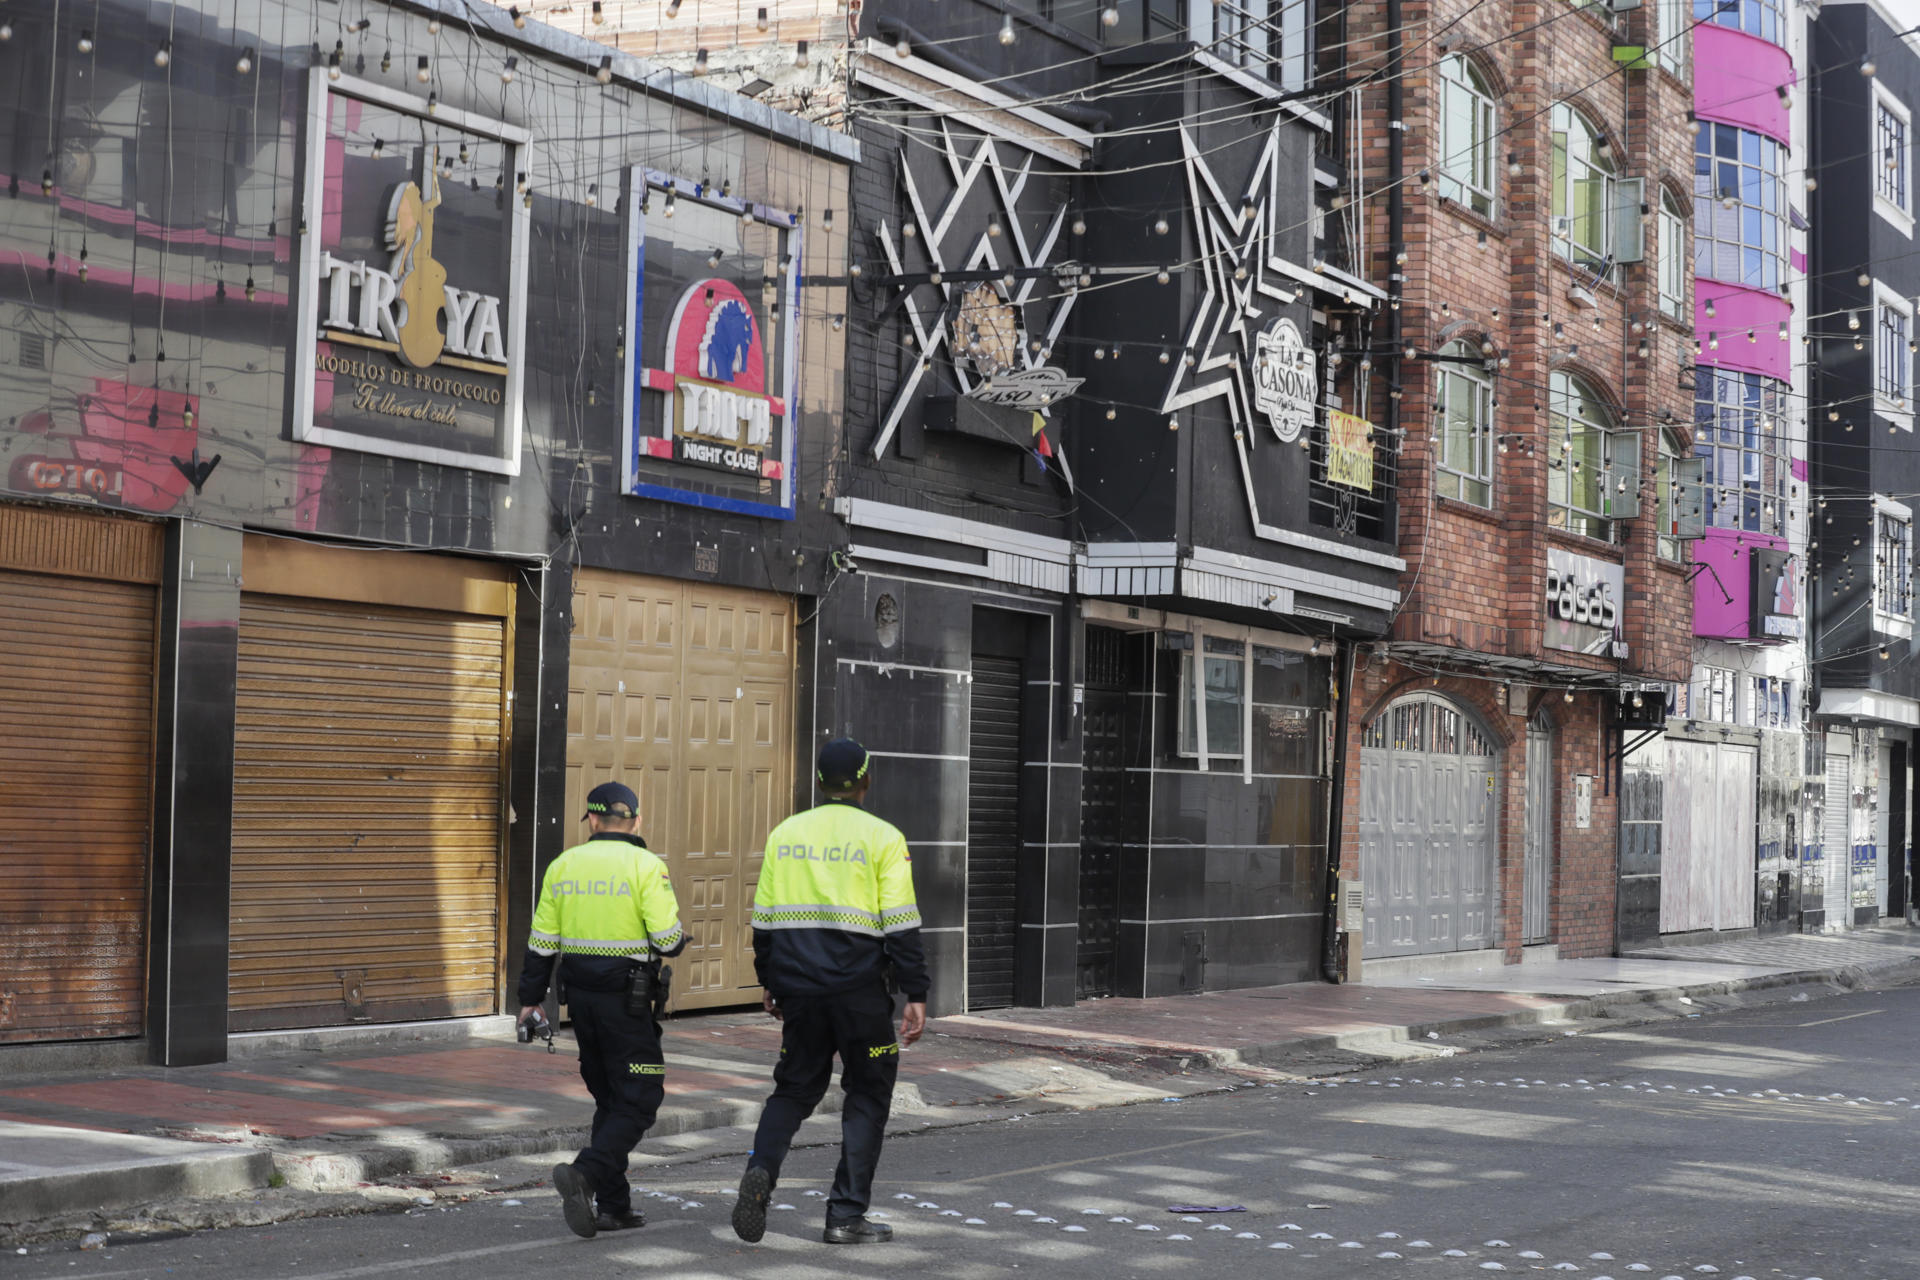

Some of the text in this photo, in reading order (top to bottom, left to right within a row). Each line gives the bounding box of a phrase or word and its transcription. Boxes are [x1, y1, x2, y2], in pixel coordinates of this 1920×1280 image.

[1281, 346, 1293, 367] LA
[315, 354, 500, 405] MODELOS DE PROTOCOLO
[1260, 363, 1312, 402] CASONA
[683, 442, 758, 471] NIGHT CLUB
[777, 842, 867, 865] POLICÍA
[552, 874, 632, 899] POLICÍA
